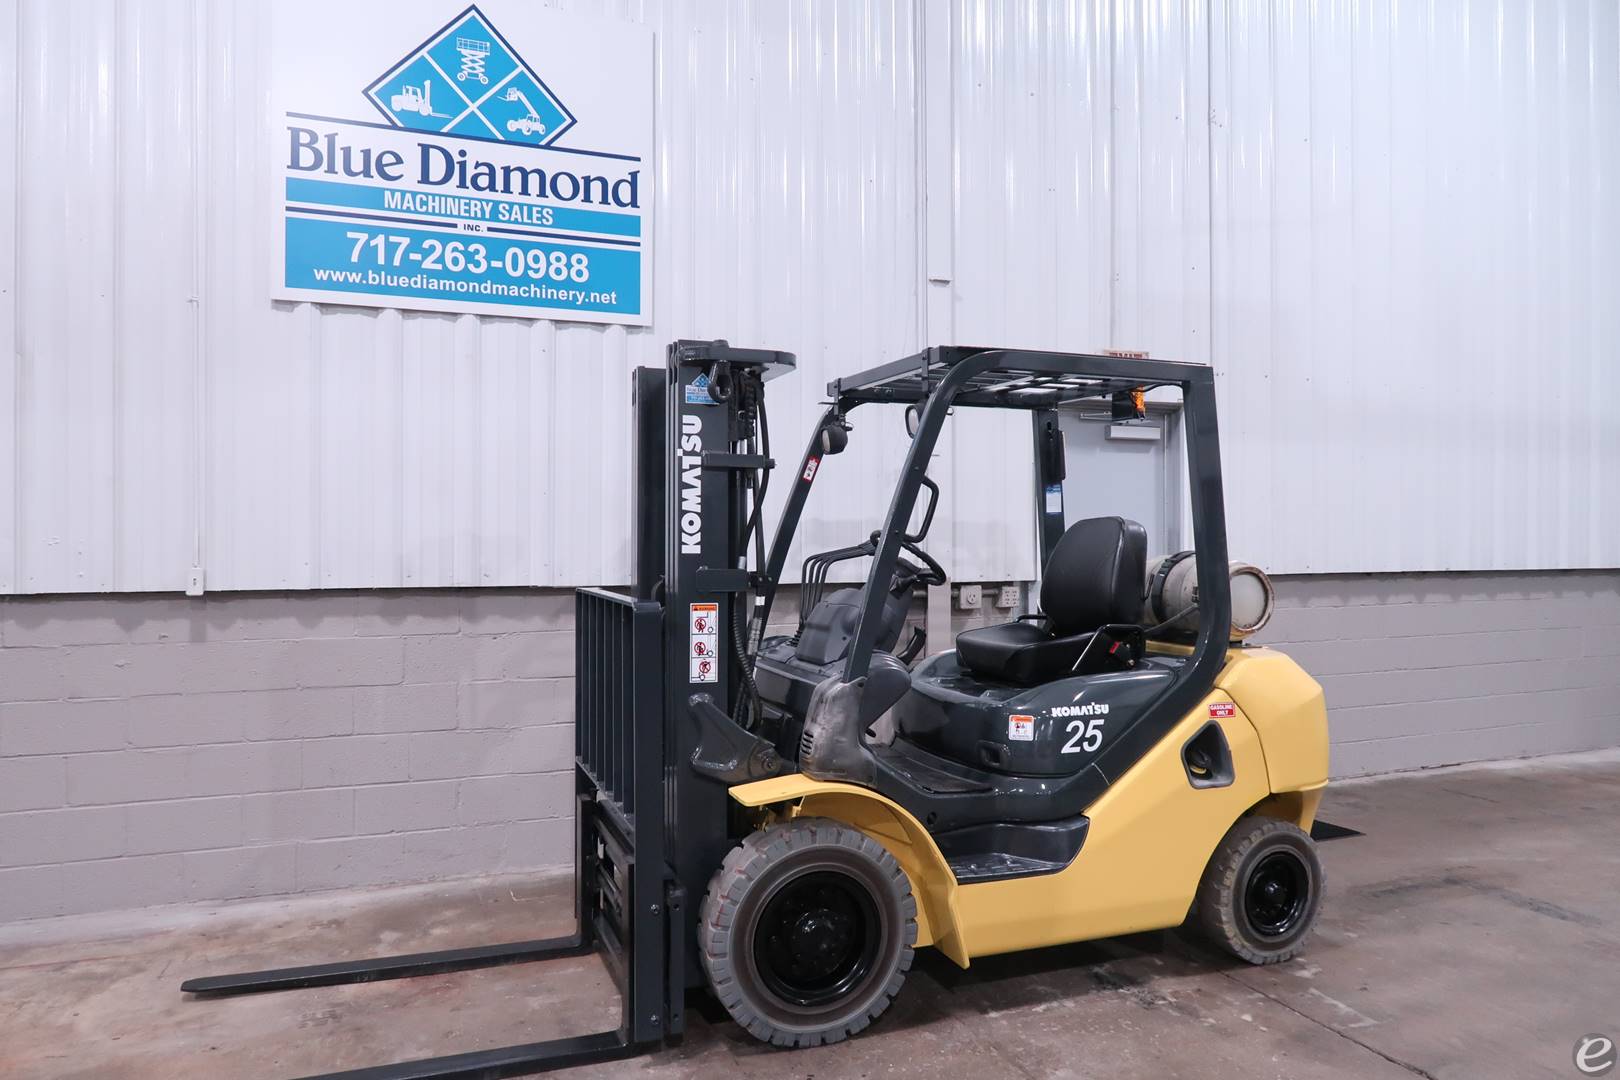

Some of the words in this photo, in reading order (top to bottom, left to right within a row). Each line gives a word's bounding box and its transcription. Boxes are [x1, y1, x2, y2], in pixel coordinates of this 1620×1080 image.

[286, 126, 404, 182] Blue
[417, 142, 641, 209] Diamond
[384, 190, 493, 219] MACHINERY
[498, 203, 554, 226] SALES
[463, 224, 484, 233] INC.
[346, 231, 590, 283] 717-263-0988
[313, 268, 617, 305] www.bluediamondmachinery.net
[677, 414, 703, 554] KOMATSU
[1051, 701, 1110, 718] KOMATSU
[1061, 719, 1105, 754] 25
